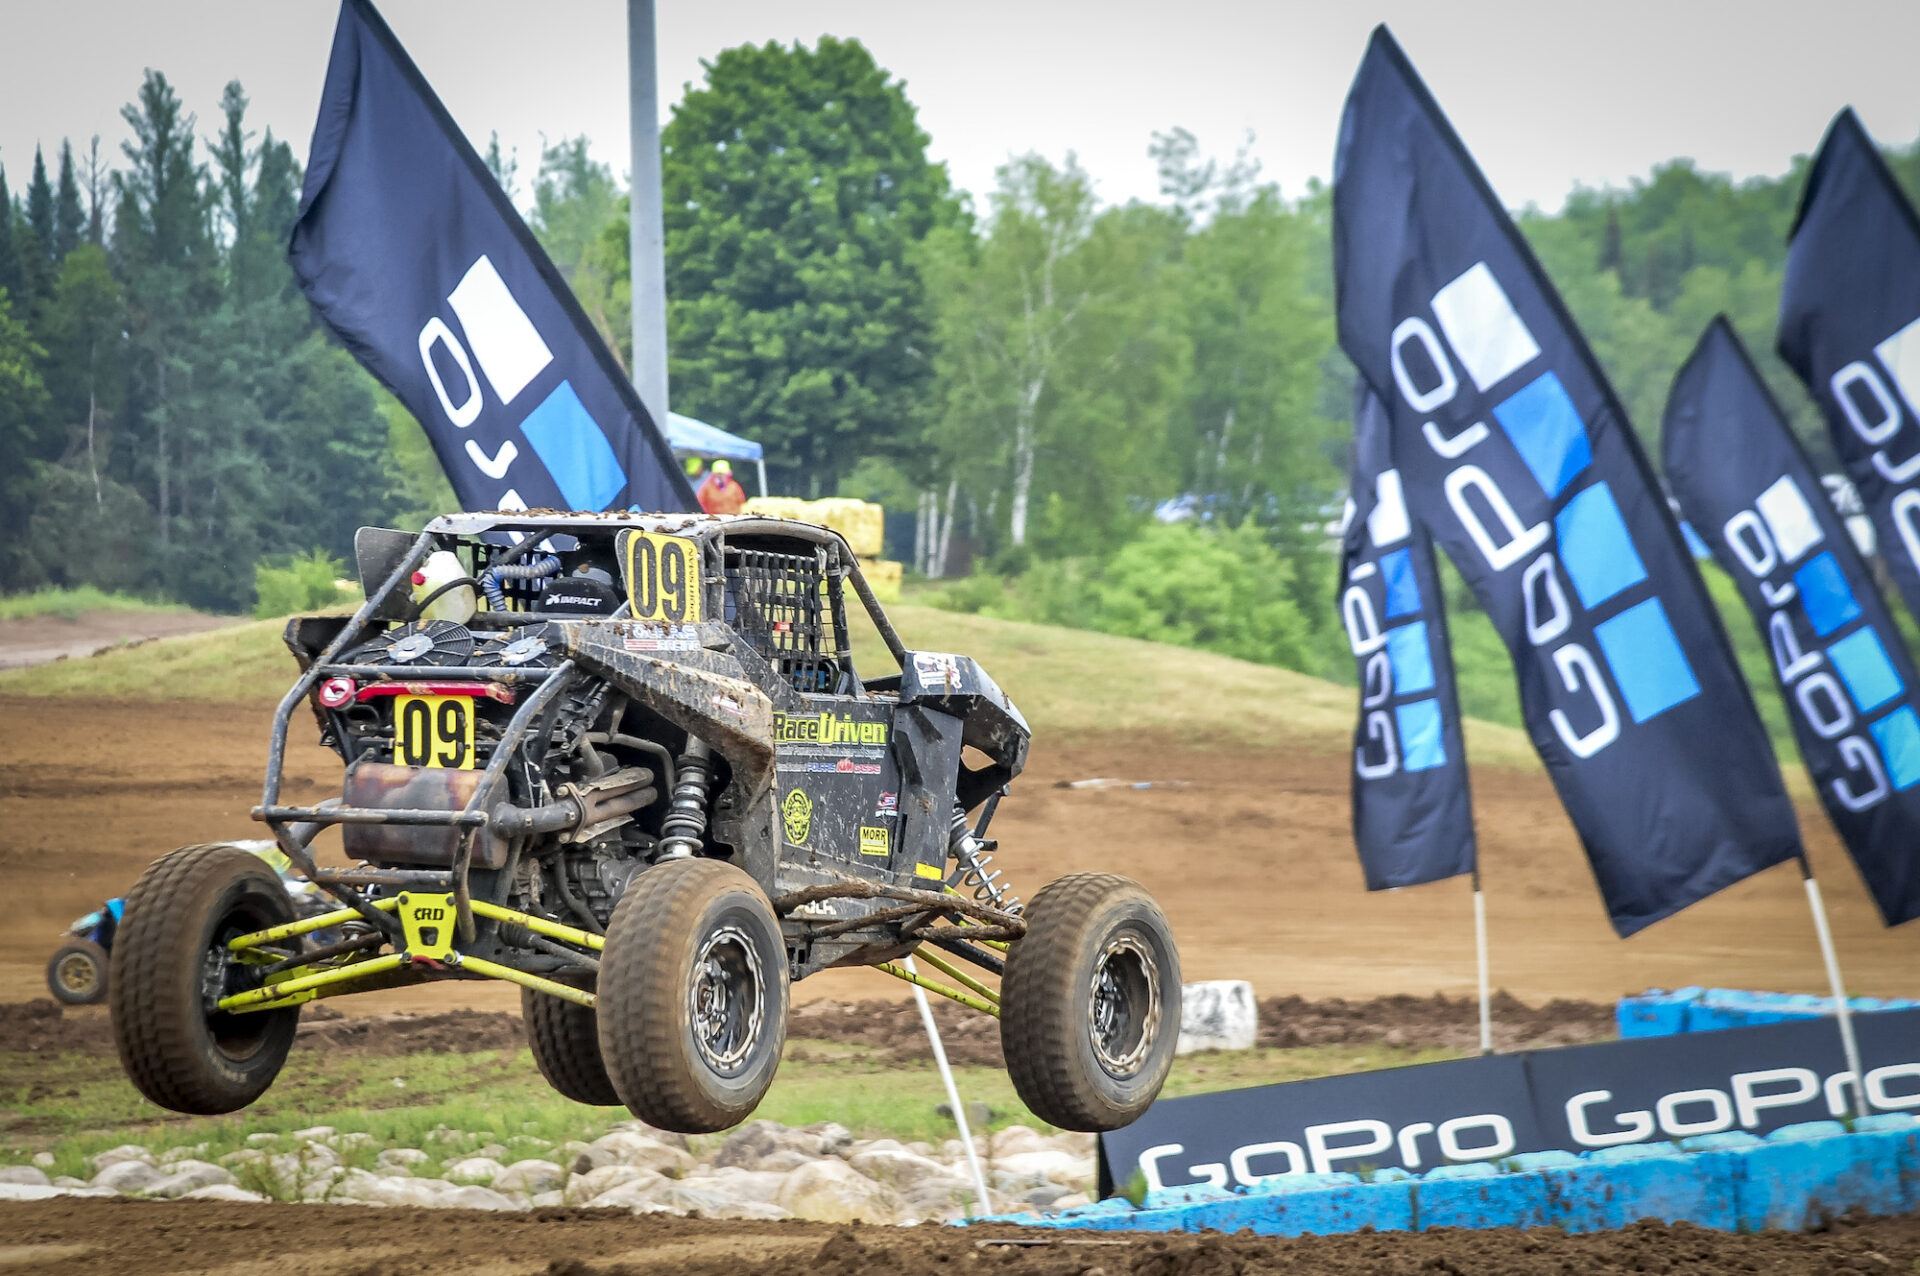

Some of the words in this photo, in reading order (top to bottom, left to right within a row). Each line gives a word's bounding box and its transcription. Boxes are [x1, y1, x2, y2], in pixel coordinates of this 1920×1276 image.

[1391, 316, 1620, 758] GoPro
[560, 595, 602, 606] IMPACT
[633, 536, 686, 622] 09
[1723, 509, 1889, 812] GoPro
[403, 699, 466, 768] 09
[773, 710, 887, 744] RaceDriven
[862, 829, 886, 840] MORR
[414, 907, 445, 920] CRD
[1565, 1063, 1920, 1147] GoPro
[1139, 1114, 1516, 1191] GoPro
